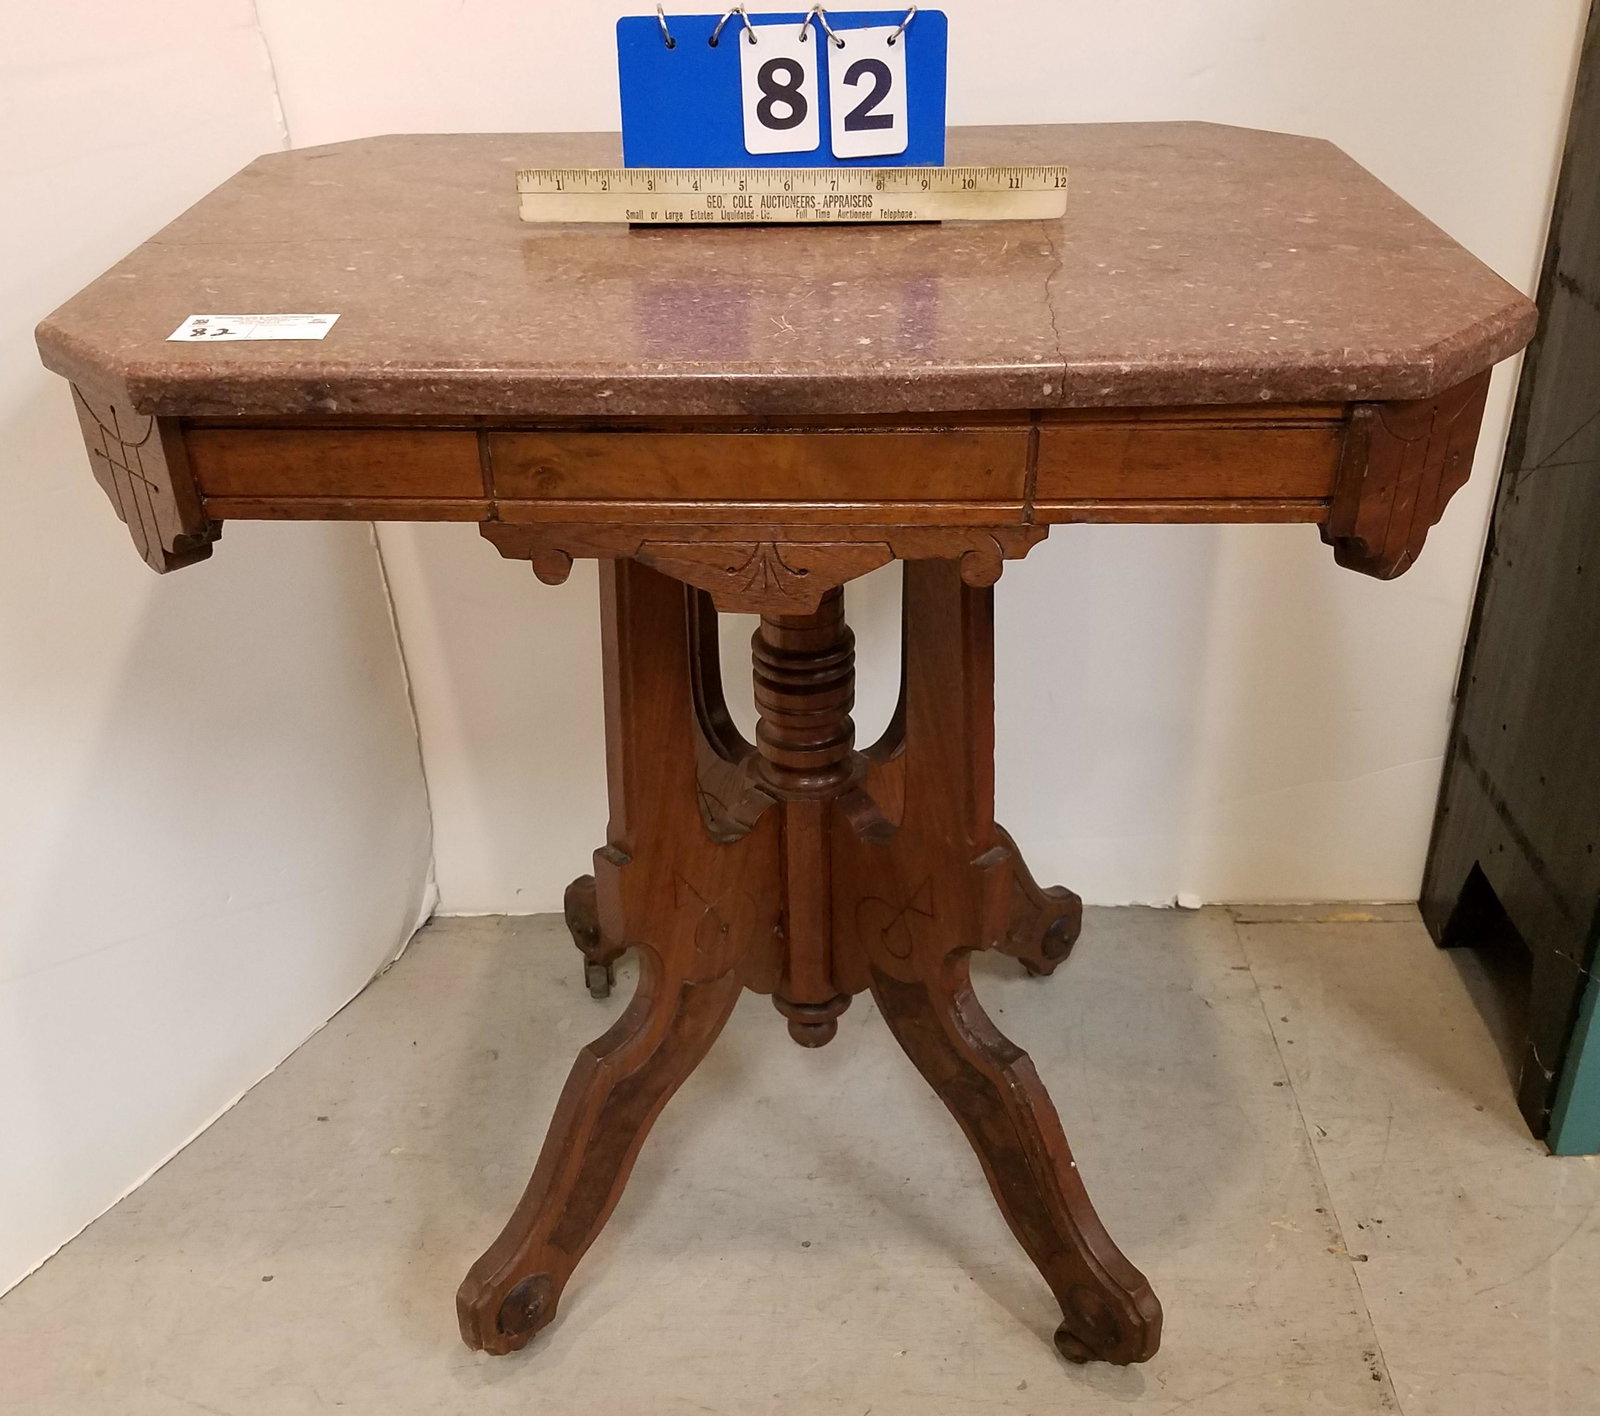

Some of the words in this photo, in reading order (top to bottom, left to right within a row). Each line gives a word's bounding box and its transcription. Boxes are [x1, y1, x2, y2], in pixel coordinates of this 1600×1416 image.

[556, 180, 562, 191] 1
[601, 181, 608, 191] 2
[647, 180, 653, 191] 3
[692, 181, 699, 191] 4
[738, 181, 745, 191] 5
[783, 180, 791, 191] 6
[830, 180, 837, 191] 7
[875, 180, 882, 190] 8
[921, 180, 928, 190] 9
[961, 178, 974, 189] 10
[1008, 178, 1020, 189] 11
[1054, 177, 1067, 188] 12
[706, 195, 725, 209] GEO.
[732, 195, 753, 209] COLE
[625, 209, 644, 220] Small
[650, 210, 658, 220] or
[665, 209, 683, 221] Large
[690, 209, 714, 220] Estates
[795, 209, 808, 219] Full
[815, 208, 831, 219] Time
[837, 208, 873, 219] Auctioneer
[189, 327, 237, 337] 82
